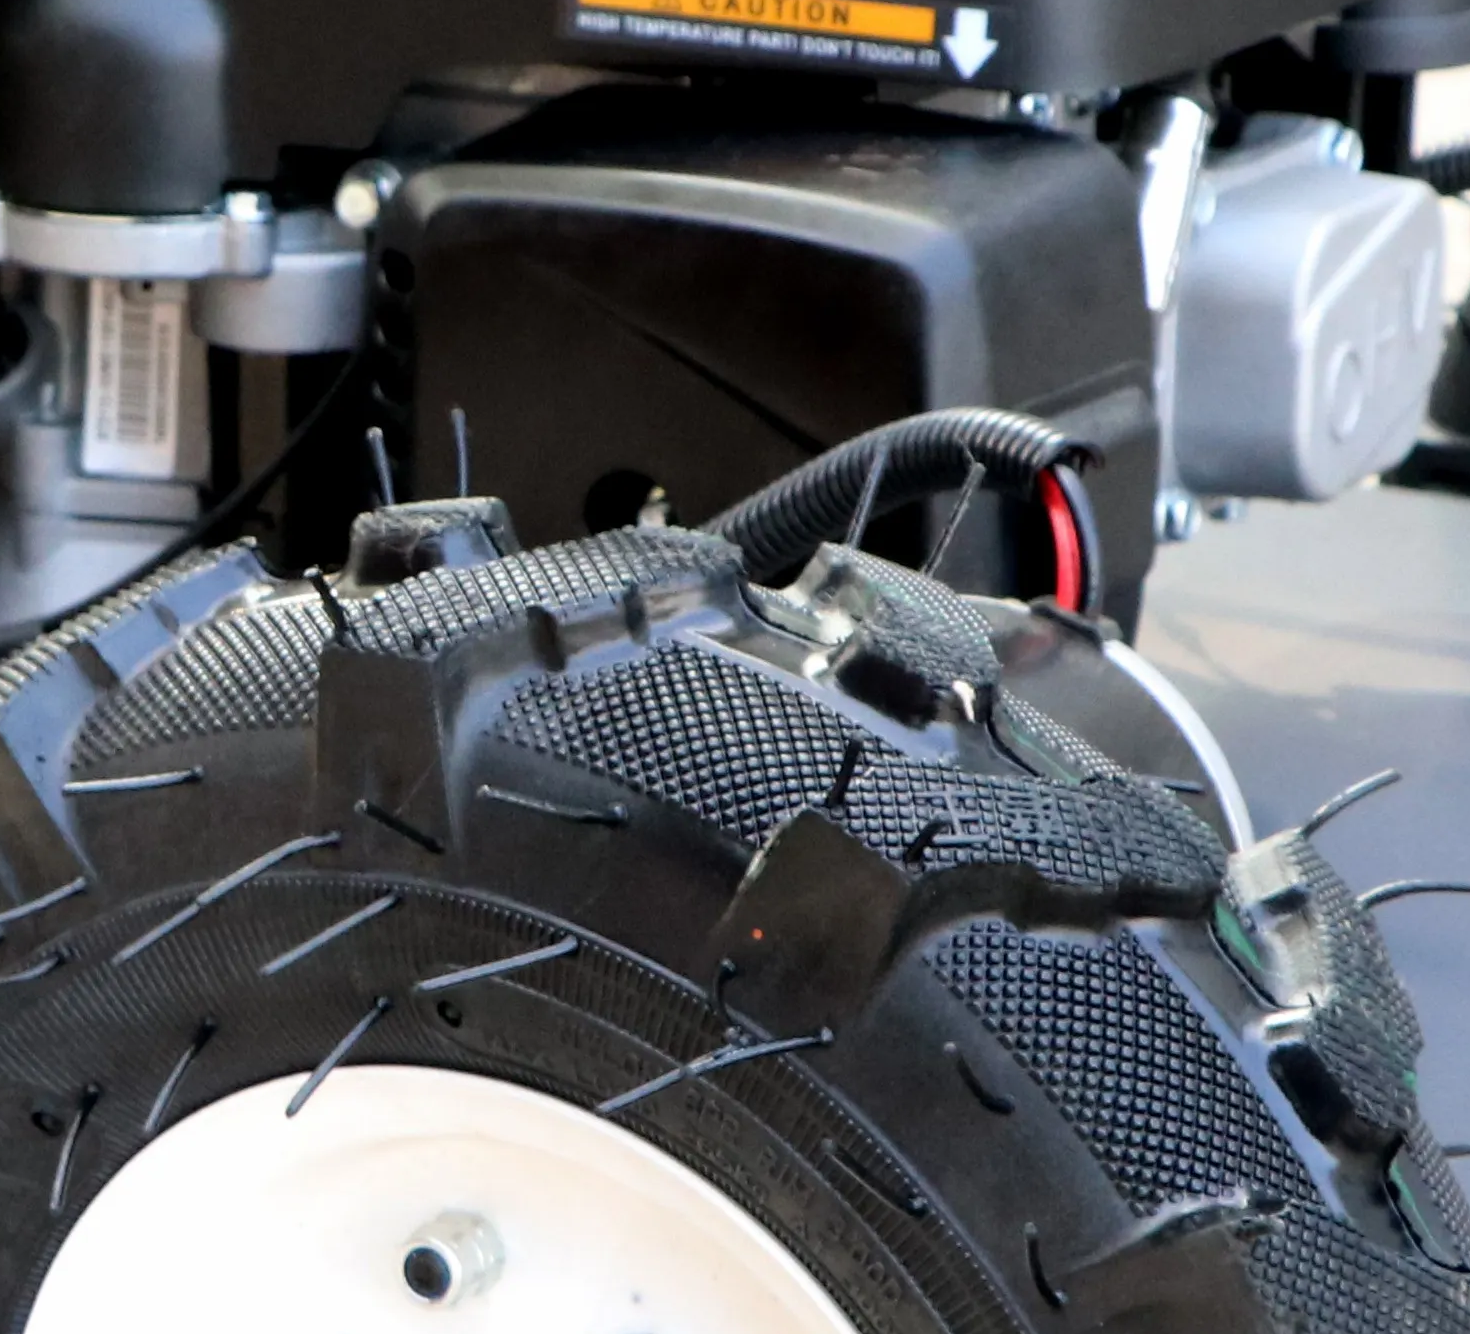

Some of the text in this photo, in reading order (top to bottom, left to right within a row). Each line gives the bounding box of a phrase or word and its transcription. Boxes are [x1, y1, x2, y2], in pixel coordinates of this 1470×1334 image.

[578, 11, 621, 33] HIGH
[625, 14, 745, 48] TEMPERATURE
[856, 40, 916, 66] TOUCH
